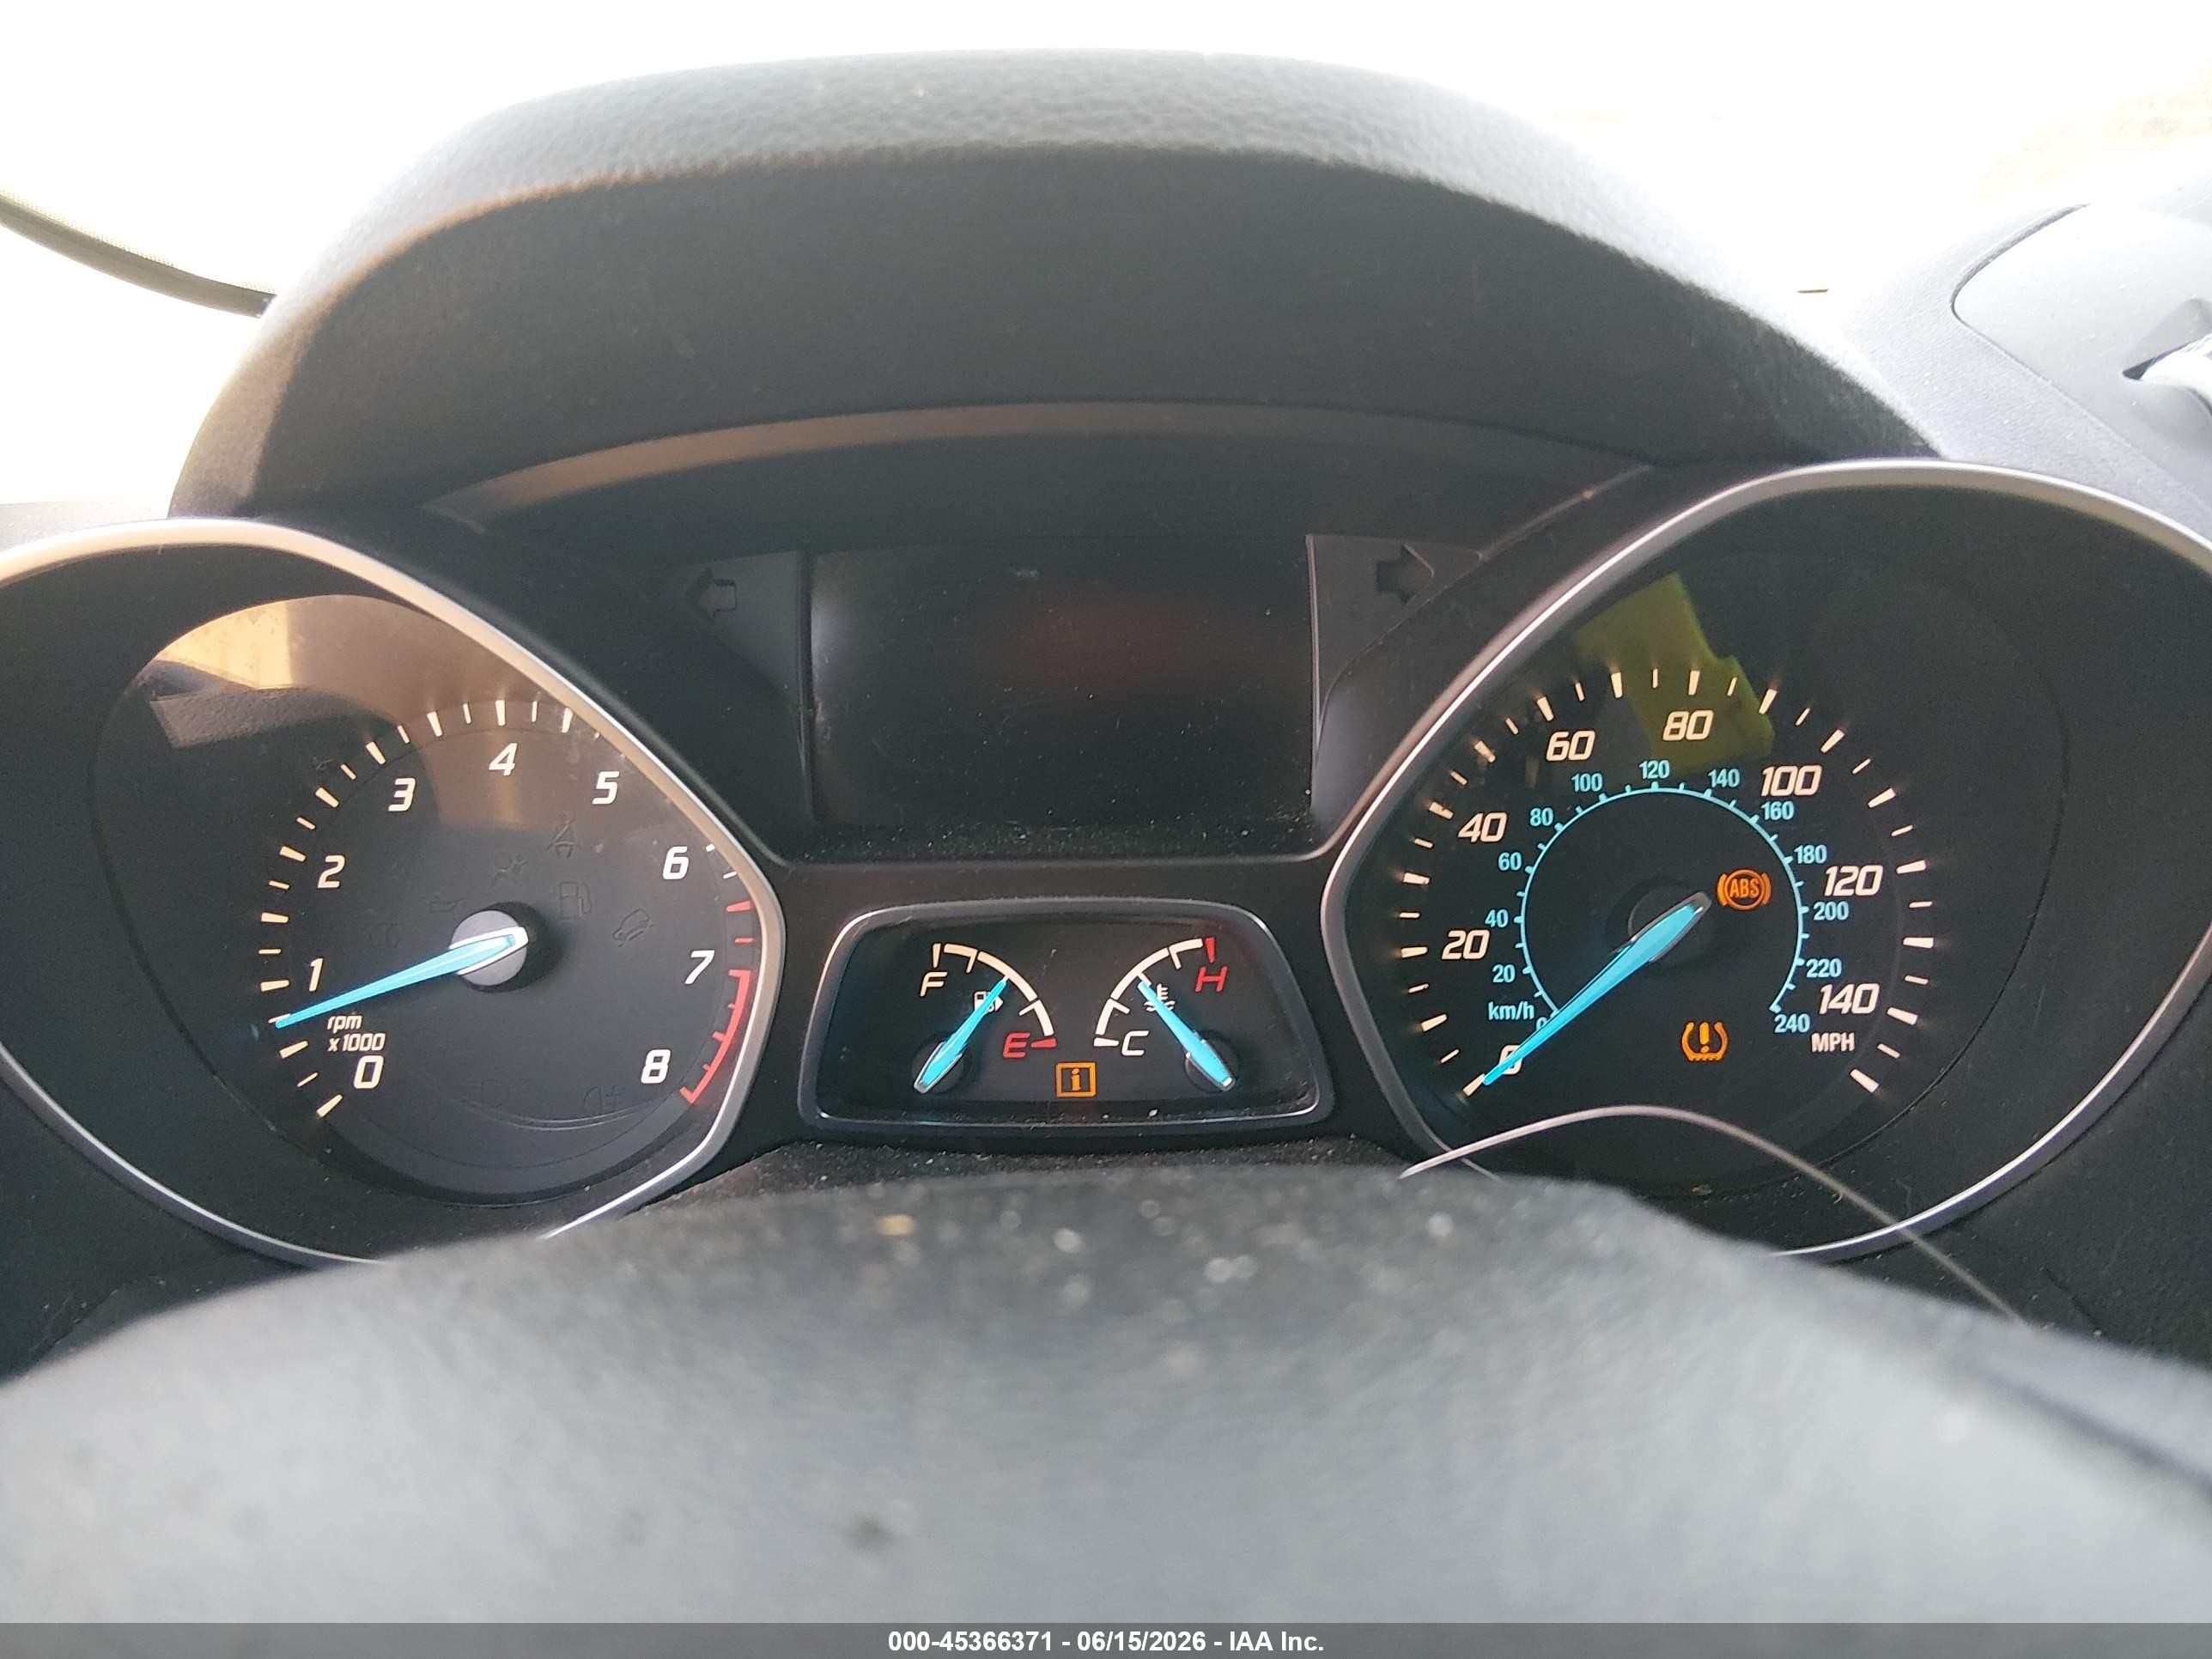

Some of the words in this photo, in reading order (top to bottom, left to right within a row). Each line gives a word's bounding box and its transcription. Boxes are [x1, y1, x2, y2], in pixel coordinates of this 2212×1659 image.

[1662, 710, 1714, 740] 80
[1546, 730, 1595, 761] 60
[489, 743, 518, 776] 4
[1639, 761, 1670, 779] 120
[592, 771, 620, 804] 5
[1571, 774, 1603, 792] 100
[1709, 769, 1741, 788] 140
[1760, 765, 1821, 797] 100
[388, 778, 416, 811] 3
[1529, 808, 1553, 827] 80
[1762, 802, 1795, 820] 160
[1458, 812, 1507, 842] 40
[663, 847, 689, 879] 6
[1498, 853, 1522, 872] 60
[1795, 845, 1827, 864] 180
[318, 855, 345, 888] 2
[1824, 866, 1883, 896] 120
[1730, 878, 1759, 898] ABS
[1485, 910, 1509, 928] 40
[1814, 902, 1849, 921] 200
[1442, 930, 1490, 960] 20
[309, 958, 323, 991] 1
[685, 950, 714, 984] 7
[1194, 967, 1227, 992] H
[1492, 964, 1515, 984] 20
[1807, 958, 1842, 977] 220
[920, 972, 948, 996] F
[1819, 984, 1880, 1014] 140
[327, 1015, 362, 1032] rpm
[1488, 1003, 1534, 1021] km/h
[1774, 1014, 1810, 1032] 240
[1003, 1033, 1030, 1058] E
[1121, 1030, 1149, 1055] C
[1812, 1033, 1855, 1052] MPH
[354, 1054, 384, 1089] 0
[641, 1049, 672, 1084] 8
